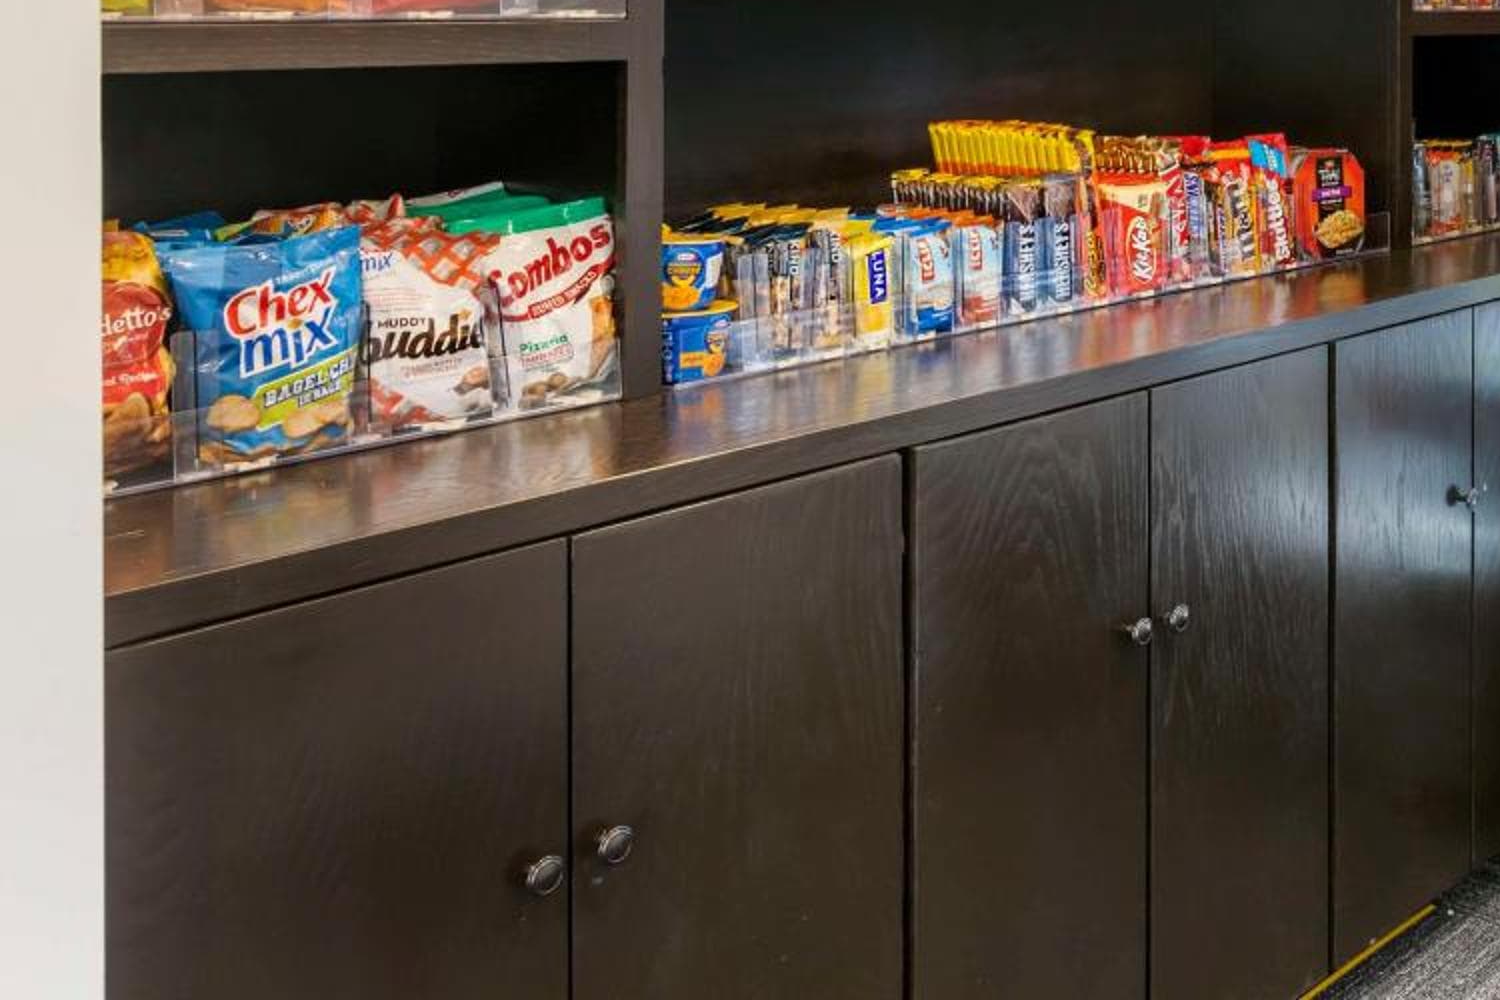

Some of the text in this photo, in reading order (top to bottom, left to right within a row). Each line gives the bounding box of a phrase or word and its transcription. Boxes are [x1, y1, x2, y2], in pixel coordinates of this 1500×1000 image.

[226, 271, 334, 337] Chex
[870, 251, 887, 300] LUNA
[242, 306, 338, 377] mix
[377, 317, 426, 329] MUDDY
